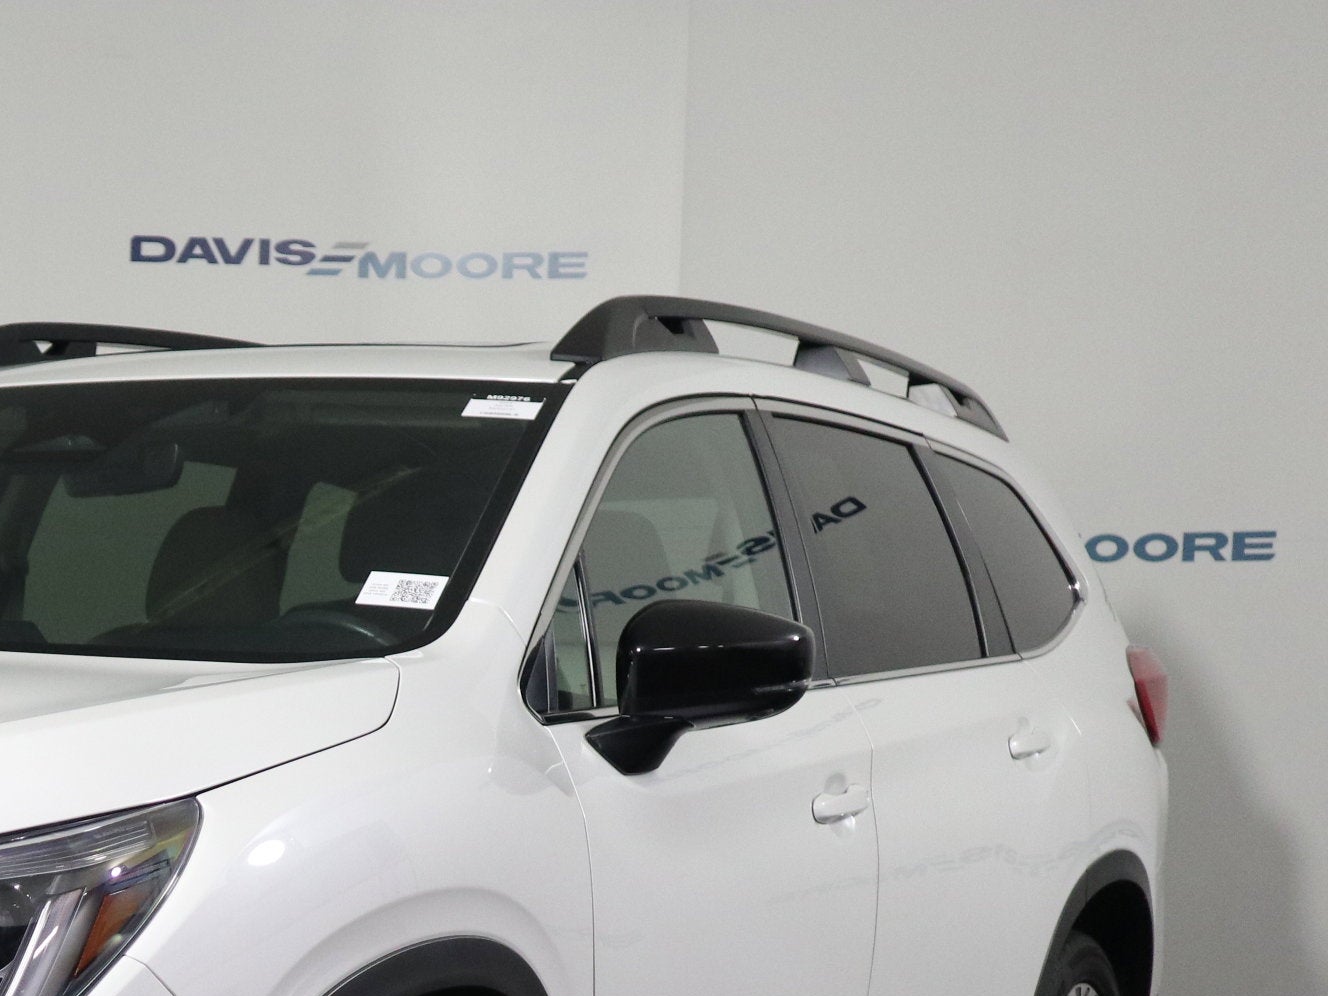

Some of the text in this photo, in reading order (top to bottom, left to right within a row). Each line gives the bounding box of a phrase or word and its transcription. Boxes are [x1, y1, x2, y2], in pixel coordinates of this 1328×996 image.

[130, 235, 589, 280] DAVIS MOORE
[1083, 530, 1277, 563] OORE
